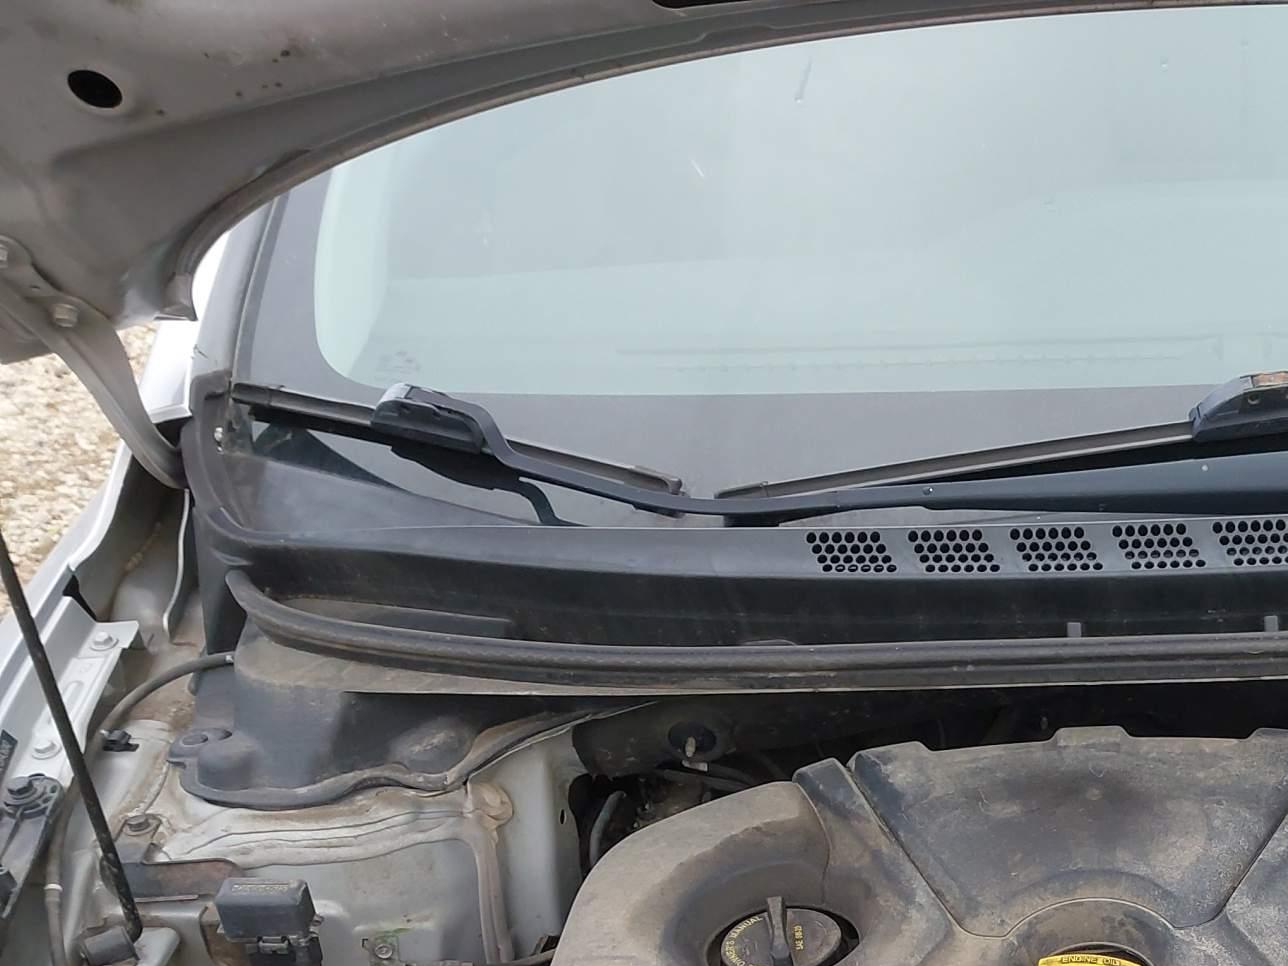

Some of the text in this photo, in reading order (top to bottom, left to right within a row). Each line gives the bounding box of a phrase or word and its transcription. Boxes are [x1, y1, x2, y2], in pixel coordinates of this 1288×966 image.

[732, 915, 763, 939] MANUAL
[1062, 955, 1120, 966] ENGINE OIL
